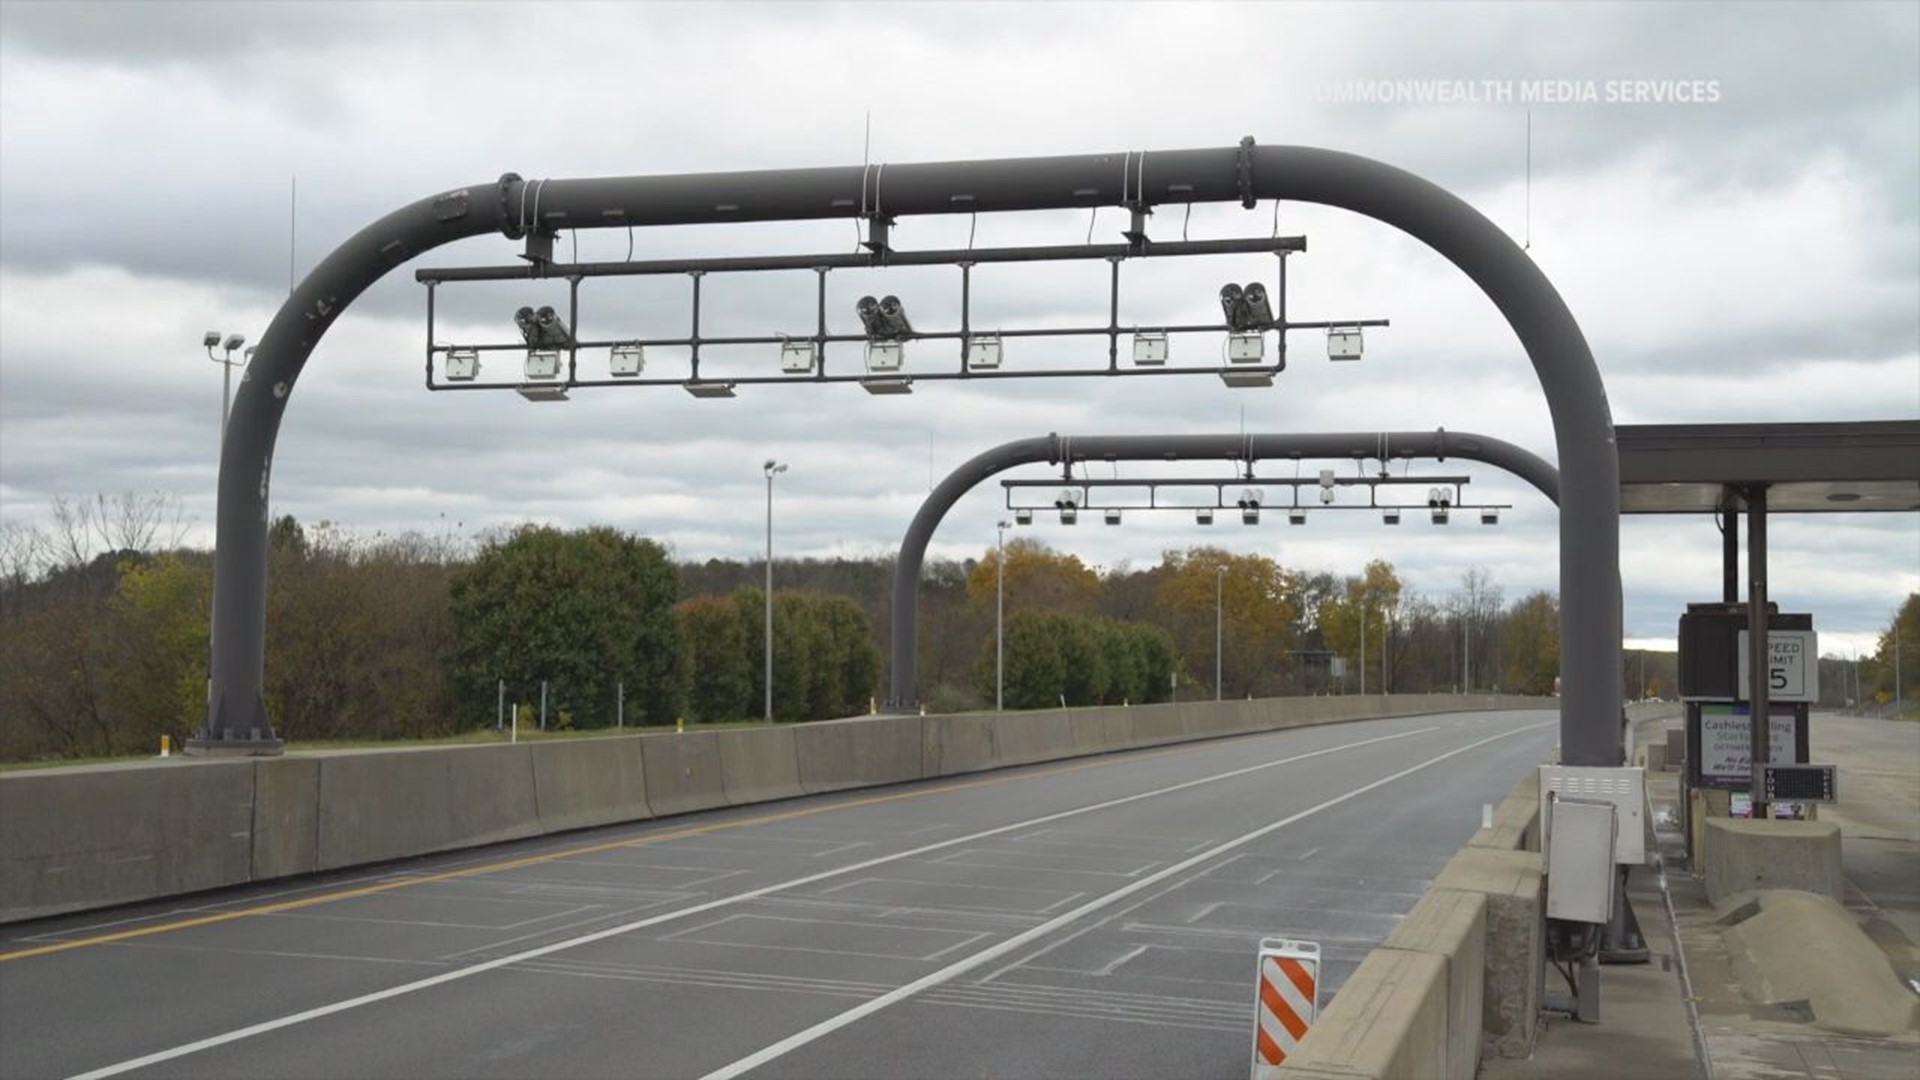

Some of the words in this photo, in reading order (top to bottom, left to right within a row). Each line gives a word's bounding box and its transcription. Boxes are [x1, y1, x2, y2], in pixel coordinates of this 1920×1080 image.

[1768, 643, 1800, 653] PEED
[1769, 655, 1795, 664] IMIT
[1770, 668, 1788, 690] 5
